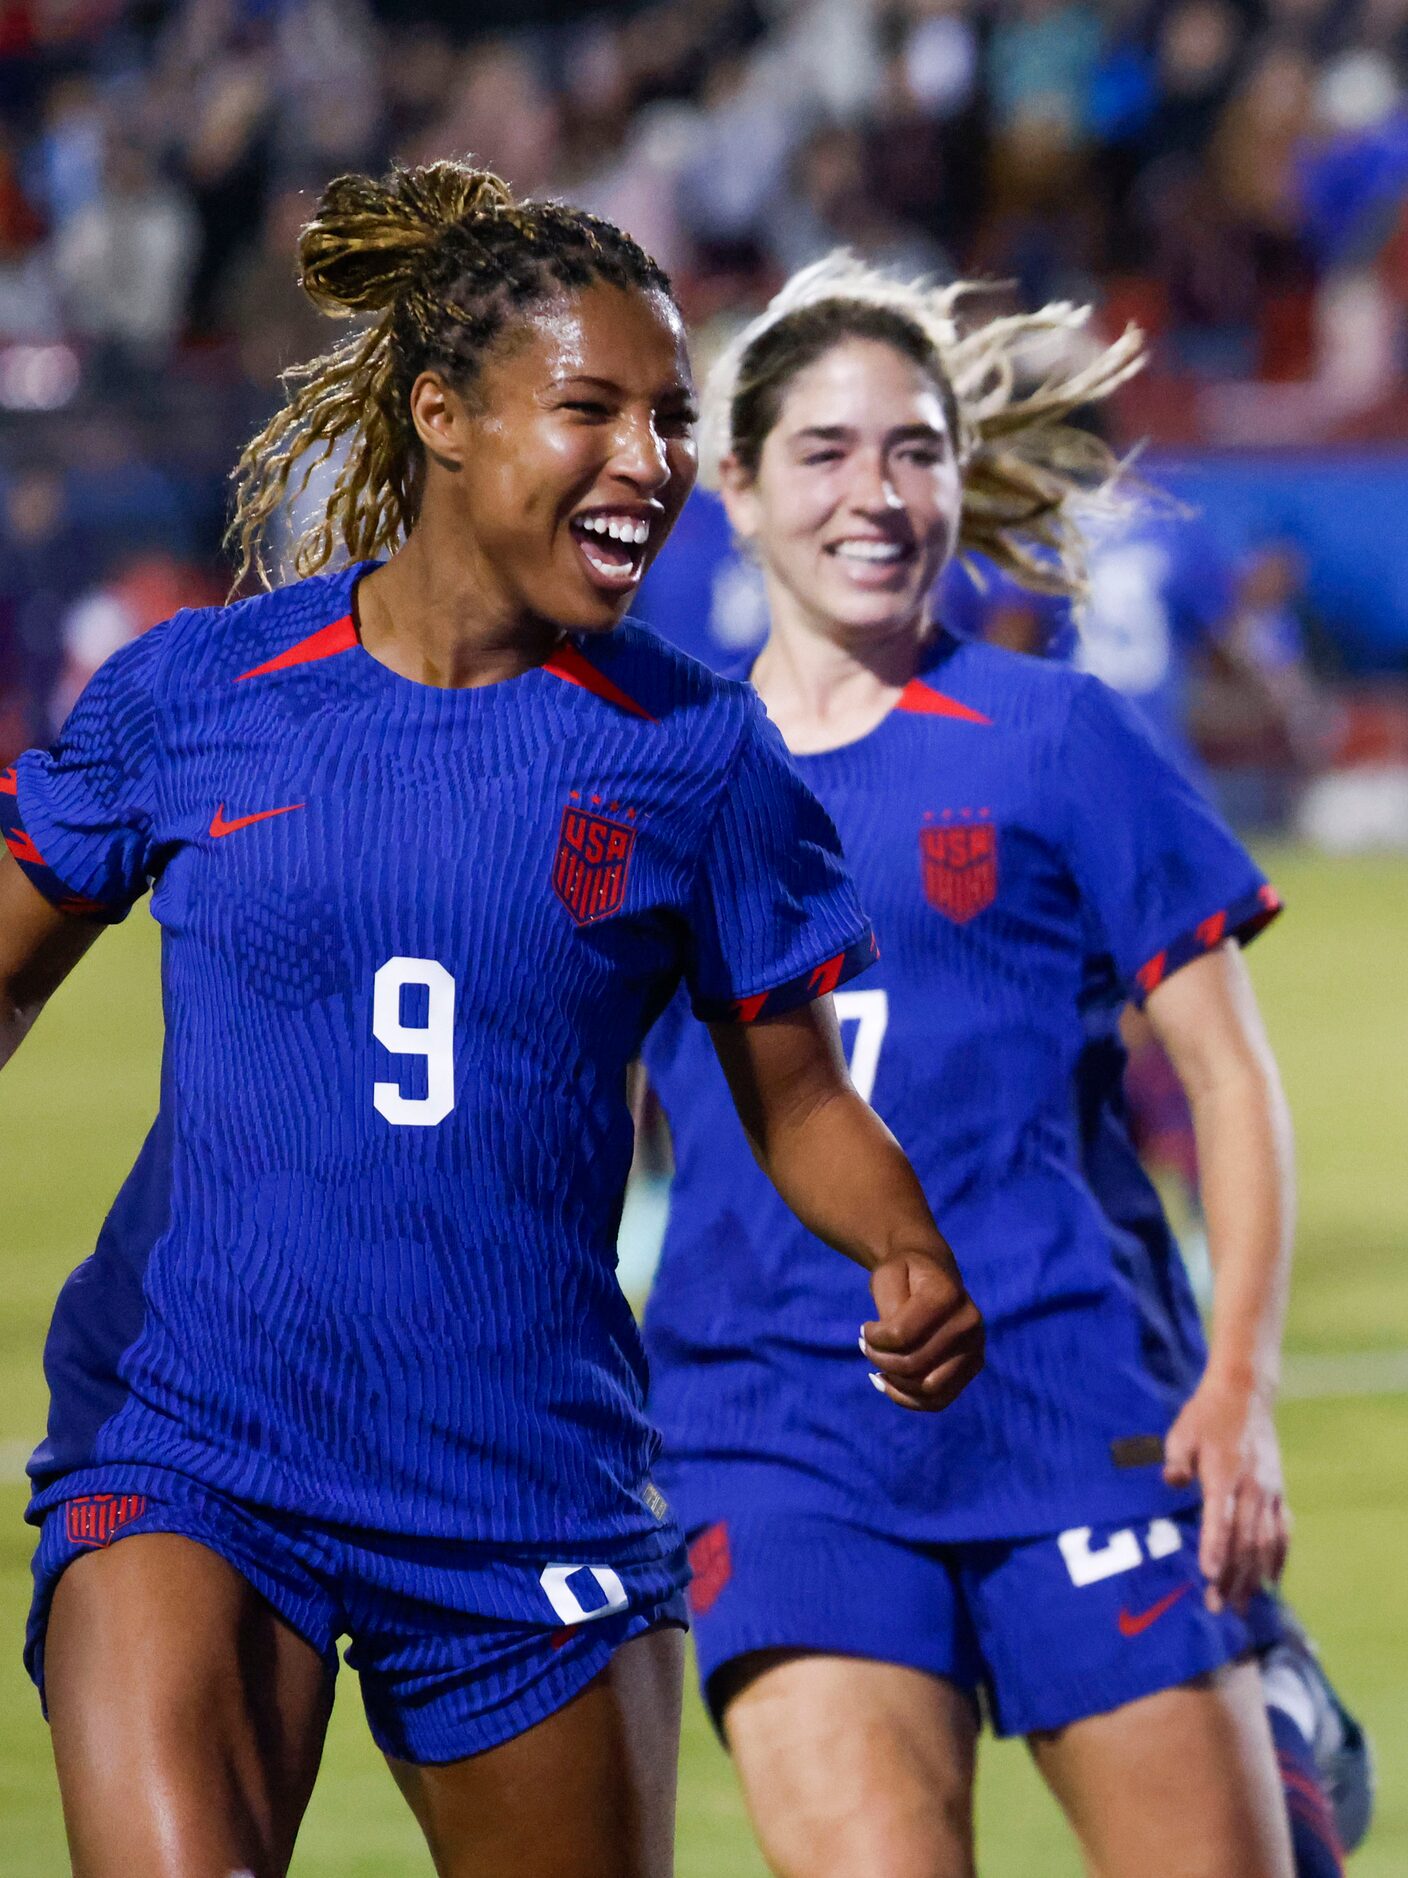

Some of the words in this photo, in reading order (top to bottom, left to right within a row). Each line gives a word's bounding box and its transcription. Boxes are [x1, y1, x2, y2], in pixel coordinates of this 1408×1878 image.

[565, 814, 629, 864] USA
[927, 831, 989, 867] USA
[372, 956, 456, 1127] 9
